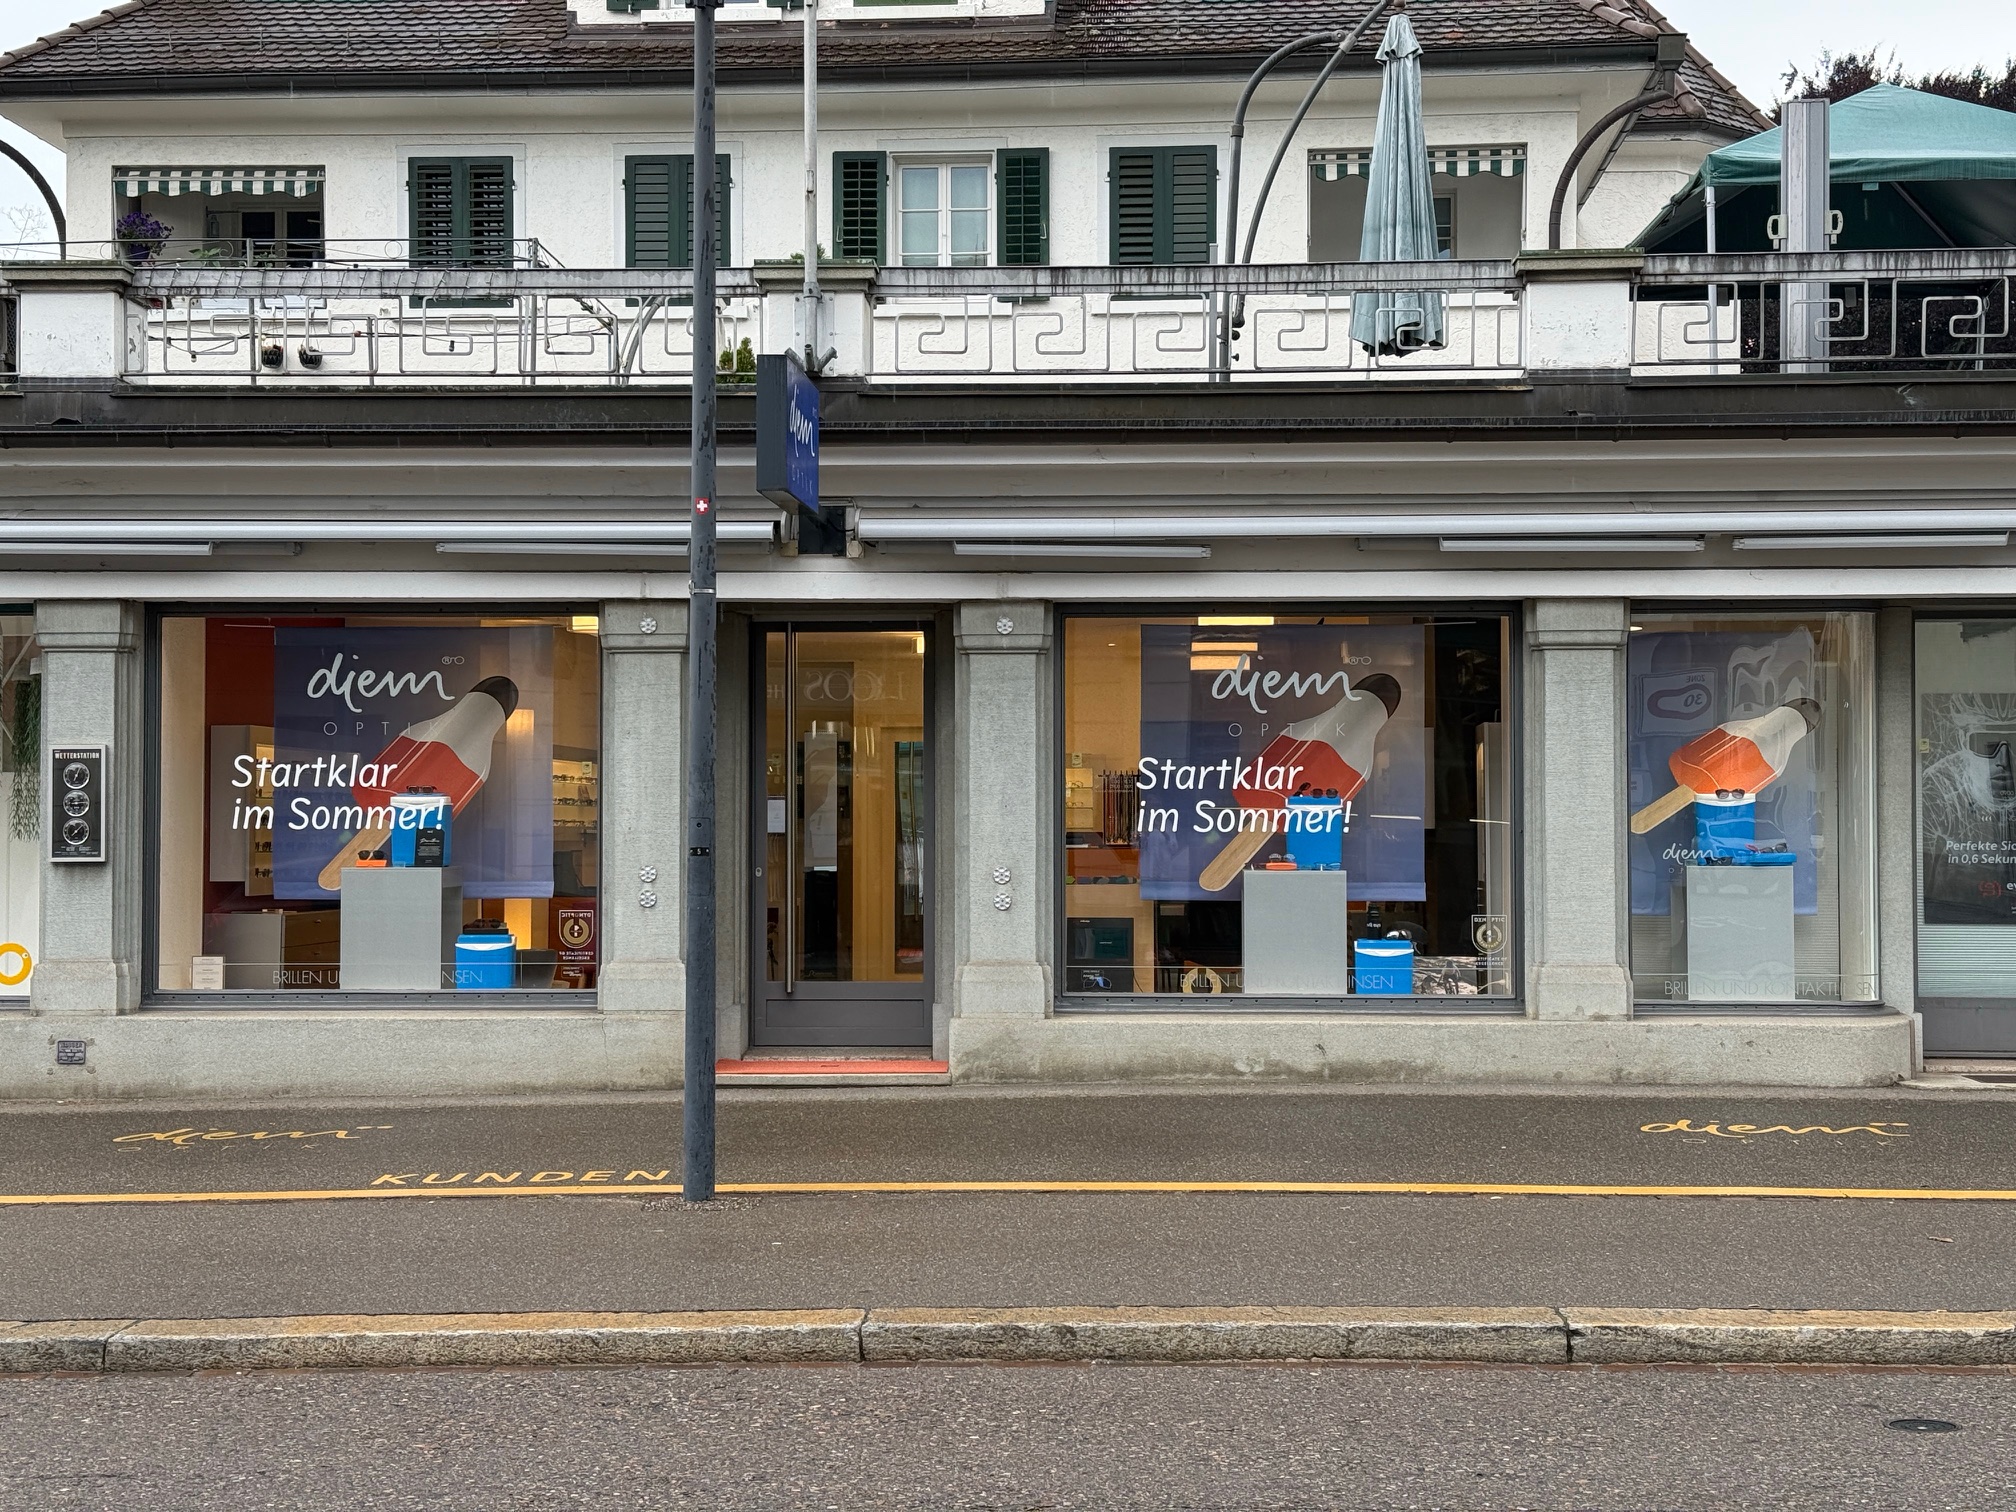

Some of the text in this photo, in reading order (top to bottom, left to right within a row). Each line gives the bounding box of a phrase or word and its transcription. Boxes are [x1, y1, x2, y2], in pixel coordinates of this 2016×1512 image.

[307, 652, 455, 713] diem
[1212, 653, 1362, 714] diem
[1228, 722, 1346, 738] OPTIK
[231, 754, 398, 788] Startklar
[1136, 756, 1304, 790] Startklar
[232, 797, 445, 830] im Sommer!
[1137, 800, 1353, 833] im Sommer!
[1662, 843, 1718, 865] diem
[1946, 841, 1998, 851] Perfekte
[1948, 854, 1959, 864] in
[1961, 854, 1979, 865] 0,6
[273, 970, 322, 984] BRILLEN
[1180, 974, 1230, 988] BRILLEN
[1664, 981, 1717, 995] BRILLEN
[1722, 981, 1759, 995] UND
[371, 1169, 671, 1185] KUNDEN
